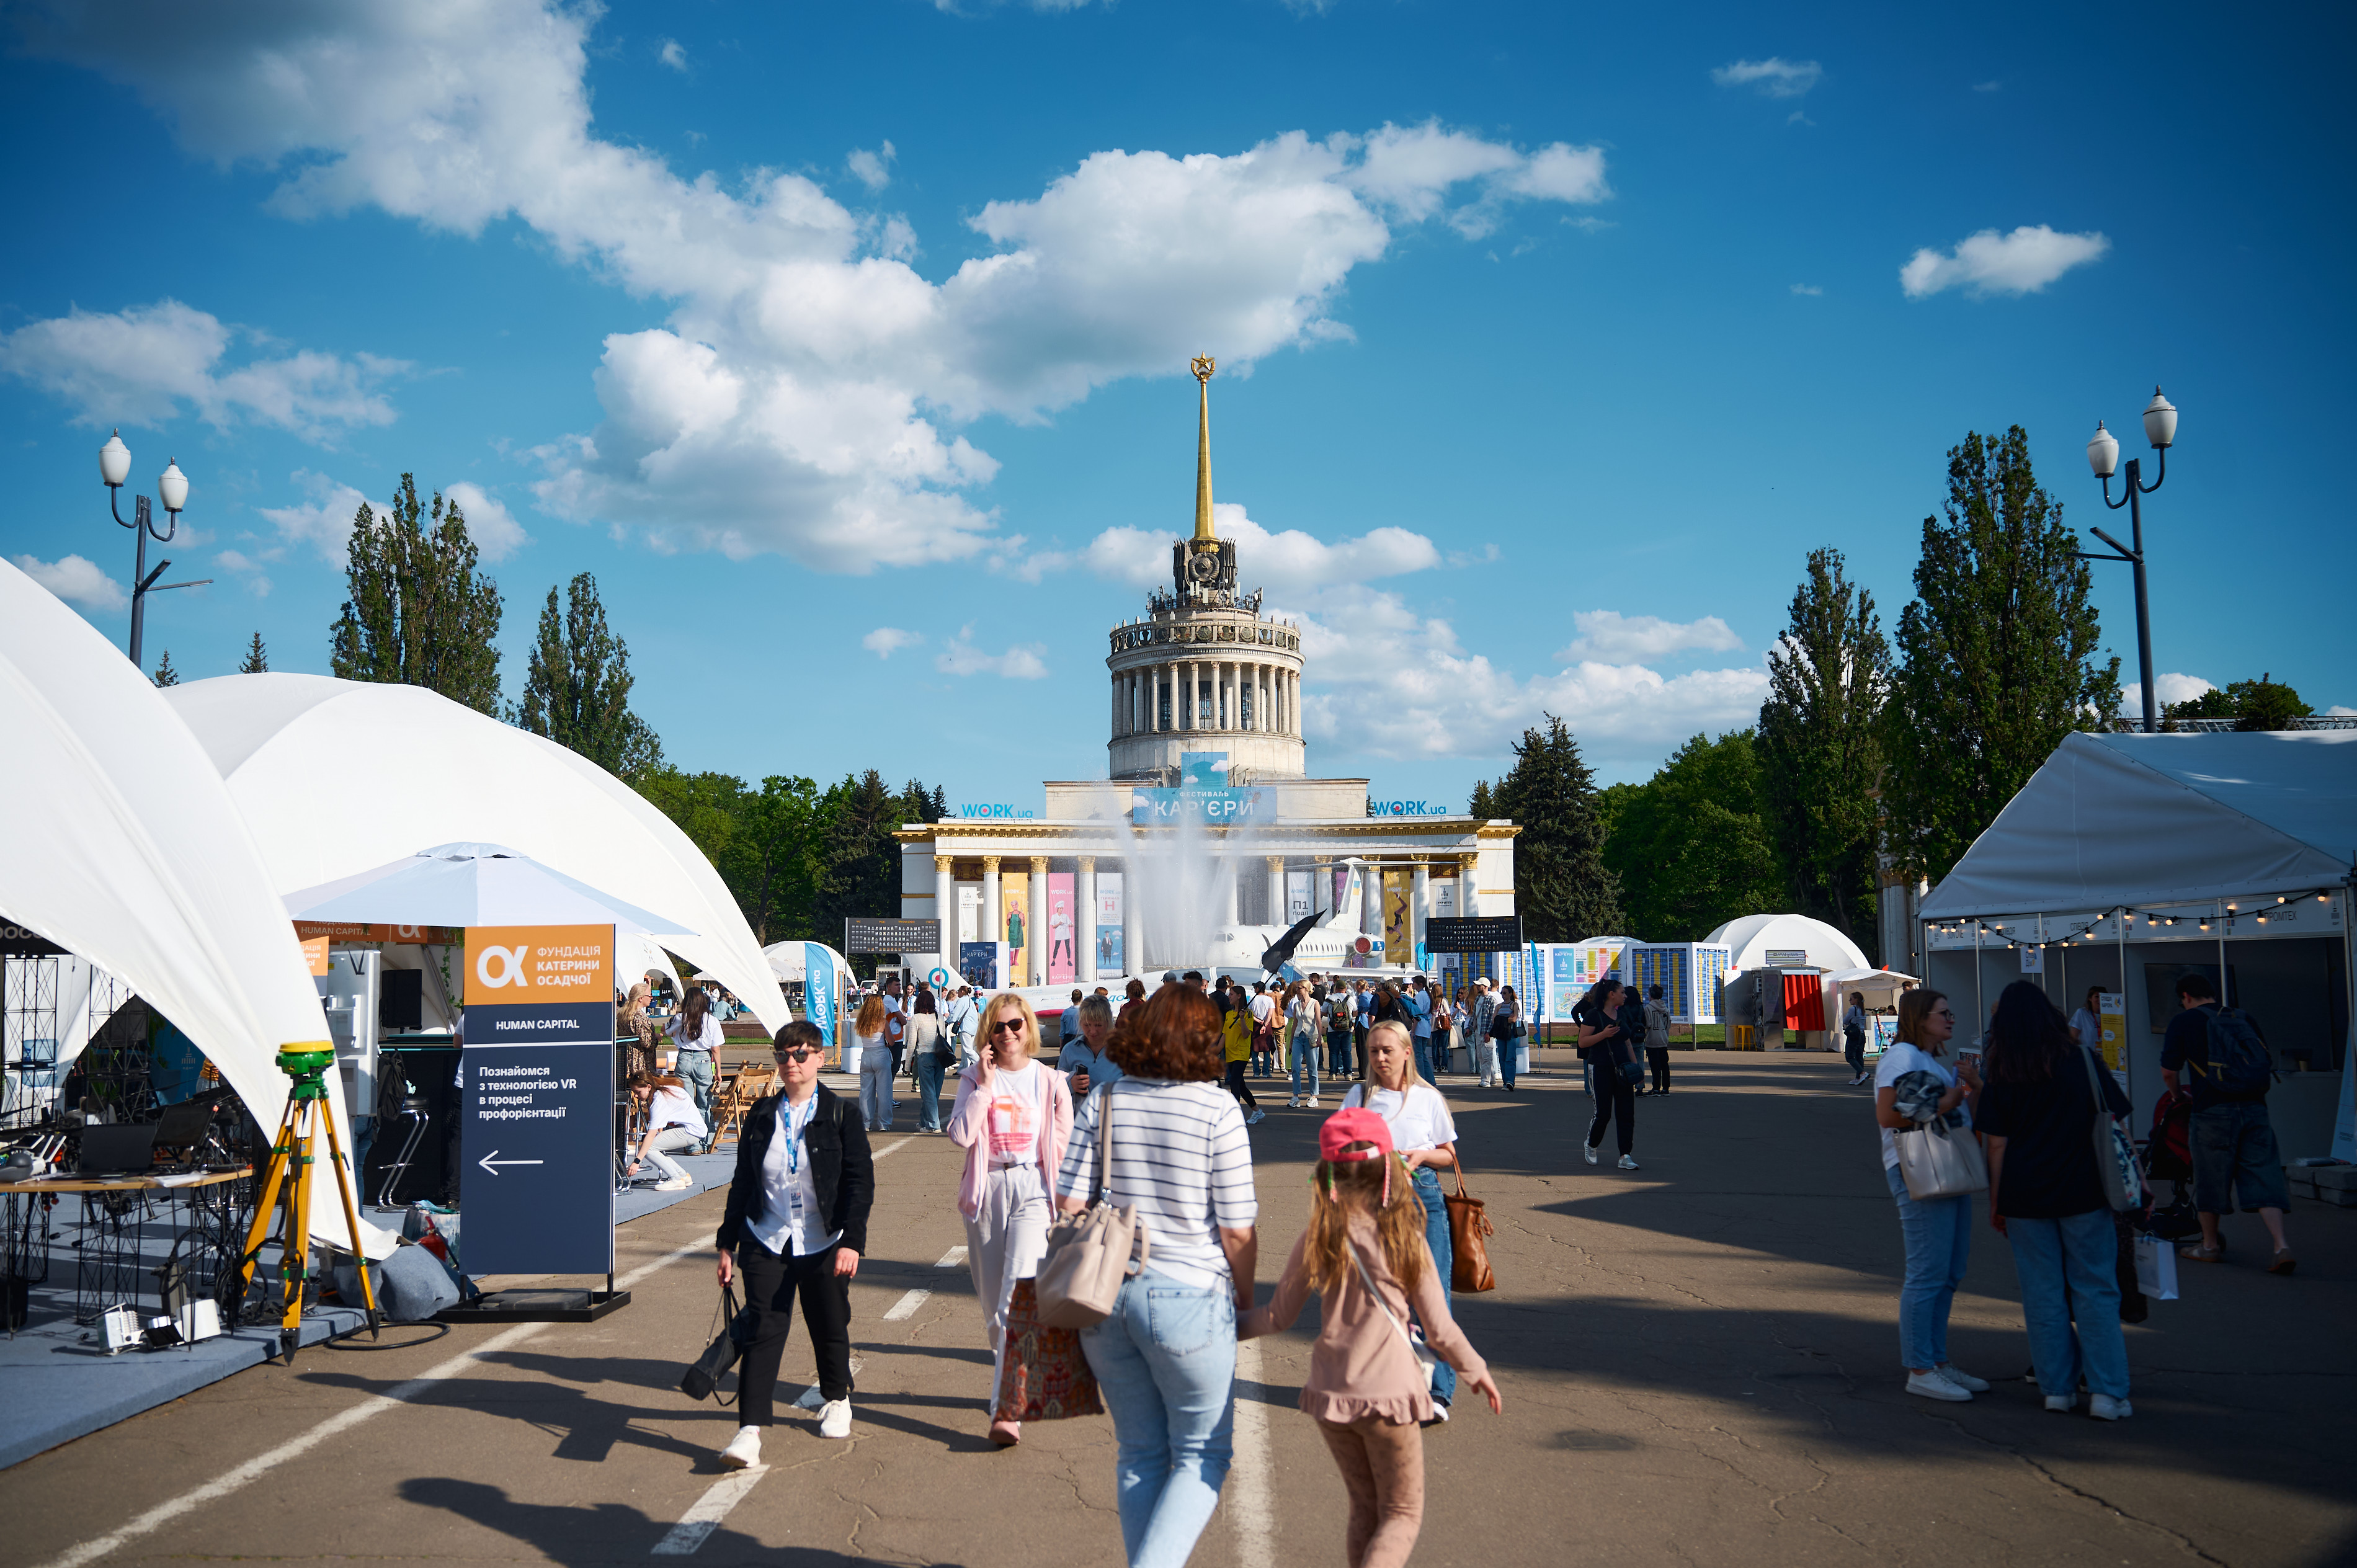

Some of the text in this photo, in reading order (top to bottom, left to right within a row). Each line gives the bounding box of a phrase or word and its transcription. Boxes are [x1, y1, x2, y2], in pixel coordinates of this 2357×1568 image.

[961, 803, 1033, 818] WORK.ua
[1373, 801, 1446, 816] WORK.ua
[537, 945, 600, 958] ФУНДАЦІЯ
[537, 960, 600, 971] КАТЕРИНИ
[537, 973, 591, 987] ОСАДЧОЇ
[496, 1020, 580, 1030] HUMAN CAPITAL
[479, 1065, 550, 1077] Познайомся
[488, 1079, 558, 1090] технологією
[561, 1079, 577, 1089] VR
[479, 1094, 533, 1107] в процесі
[479, 1107, 567, 1121] профорієнтації
